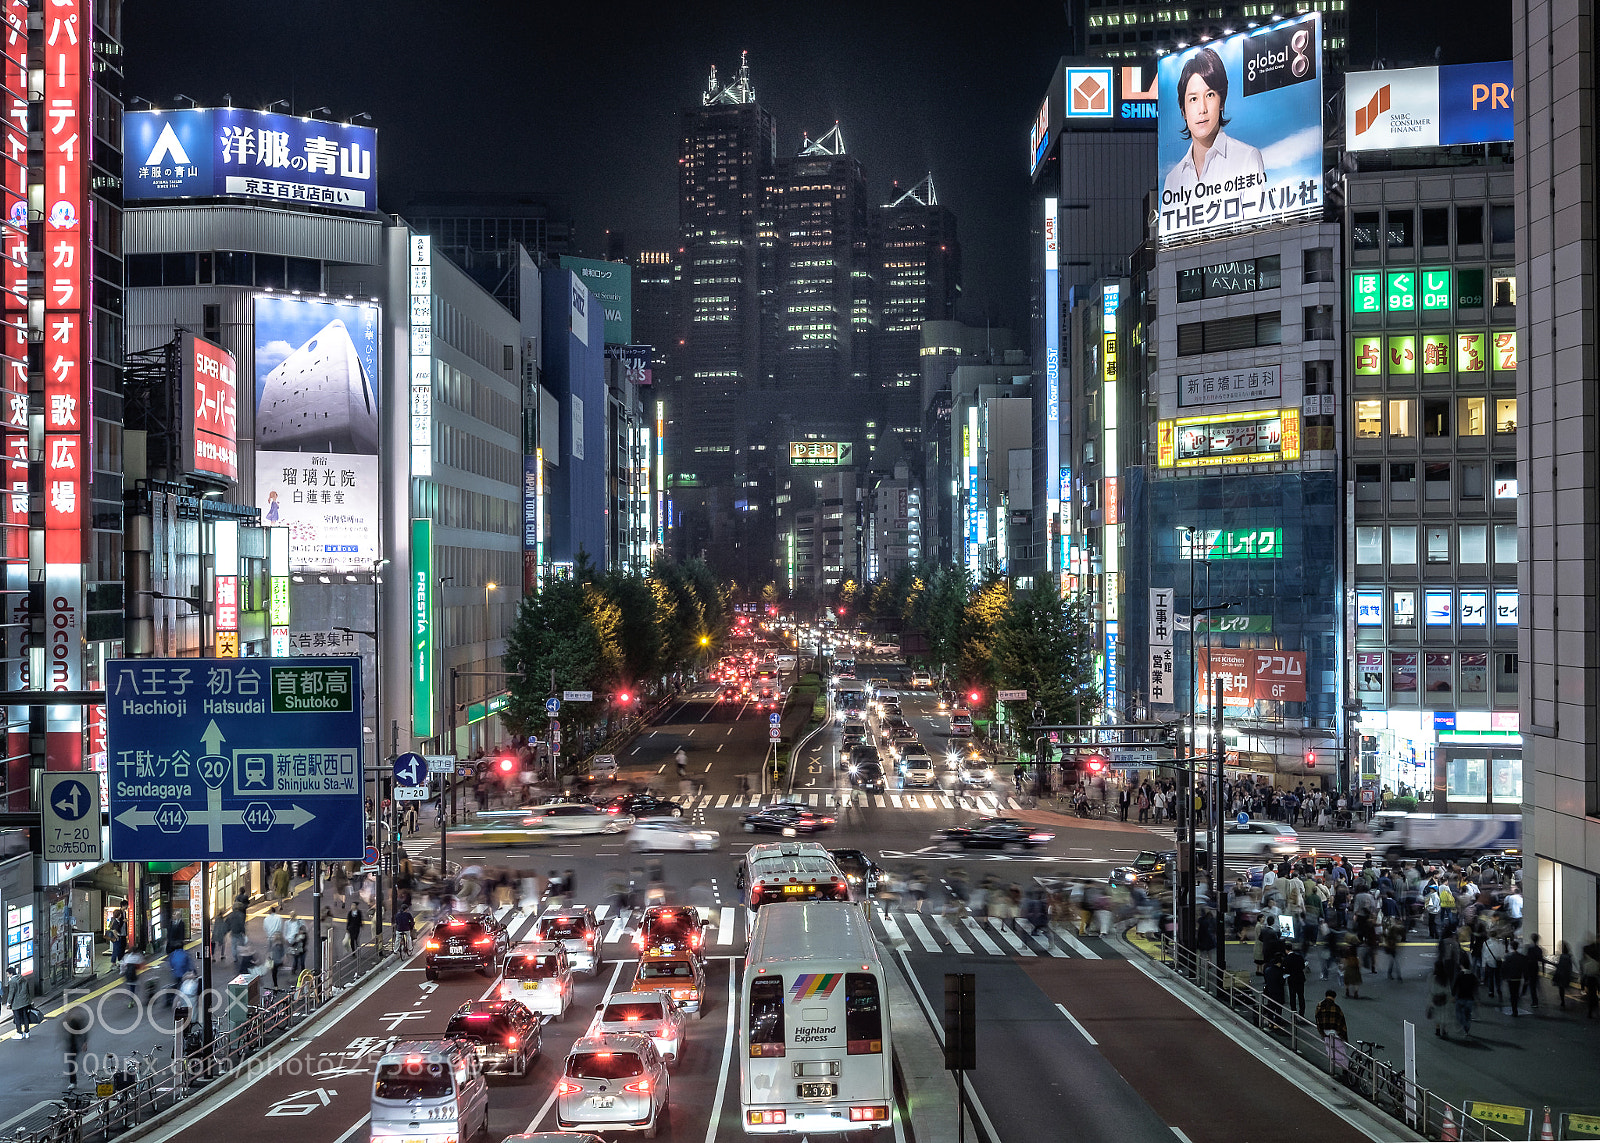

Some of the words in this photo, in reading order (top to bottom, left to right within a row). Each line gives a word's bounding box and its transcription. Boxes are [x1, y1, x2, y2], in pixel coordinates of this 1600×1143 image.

[1248, 45, 1289, 81] global
[1472, 83, 1514, 111] PR
[1121, 103, 1158, 118] SHIN
[1390, 118, 1431, 127] CONSUMER
[1390, 125, 1422, 133] FINANCE
[221, 125, 371, 180] 洋服の青山
[138, 166, 199, 178] 洋服の青山
[245, 180, 350, 203] 京王百貨店向い
[1162, 186, 1192, 206] Only
[1194, 181, 1222, 199] One
[1224, 173, 1268, 192] の住まい
[1162, 179, 1318, 231] THEグローバル社
[196, 352, 219, 380] SUPER
[1047, 347, 1058, 379] JUST
[1357, 343, 1448, 370] 占い館
[51, 241, 77, 513] カラオケ歌広場
[1187, 371, 1274, 394] 新宿矯正歯科
[793, 443, 835, 457] やまや
[282, 468, 356, 487] 瑠璃光院
[525, 470, 535, 498] JAPAN
[293, 489, 345, 504] 白蓮華堂
[525, 499, 536, 520] TOTAL
[526, 521, 536, 545] CLUB
[1227, 531, 1275, 553] レイク
[1155, 593, 1168, 640] 工事中
[1220, 616, 1250, 631] レイク
[272, 628, 288, 636] KM
[1163, 649, 1172, 673] 全館
[1221, 656, 1245, 664] Kitchen
[1257, 655, 1302, 676] アコム
[115, 669, 194, 697] 八王子
[206, 666, 262, 696] 初台
[275, 670, 347, 695] 首都高
[1152, 655, 1163, 699] 営業中
[1272, 684, 1286, 697] 6F
[122, 699, 187, 718] Hachioji
[204, 698, 265, 715] Hatsudai
[285, 695, 339, 709] Shutoko
[116, 750, 192, 777] 千駄ヶ谷
[204, 761, 224, 779] 20
[276, 753, 353, 777] 新宿駅西口
[117, 781, 192, 798] Sendagaya
[277, 778, 321, 792] Shinjuku
[399, 789, 424, 798] 7-20
[159, 811, 183, 825] 414
[247, 811, 271, 824] 414
[54, 828, 89, 840] 7-20
[48, 841, 97, 853] この先50m
[795, 1026, 837, 1036] Highland
[795, 1035, 828, 1043] Express
